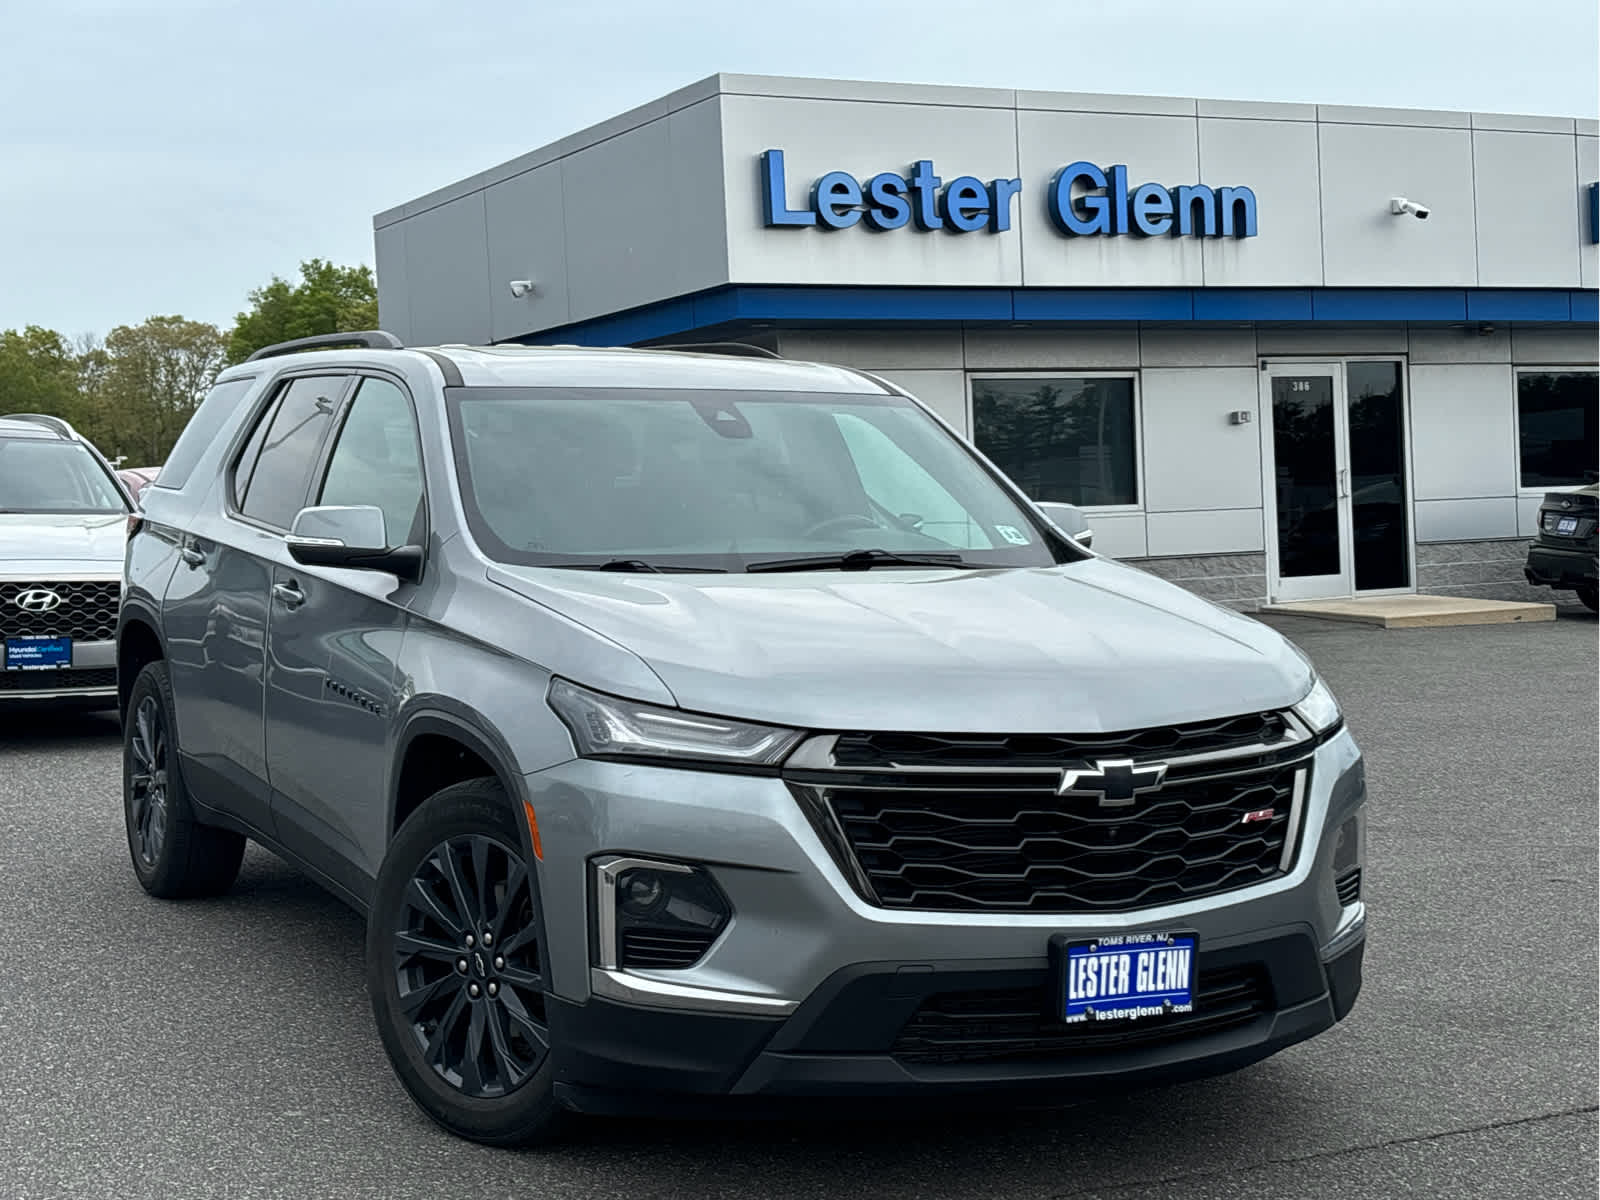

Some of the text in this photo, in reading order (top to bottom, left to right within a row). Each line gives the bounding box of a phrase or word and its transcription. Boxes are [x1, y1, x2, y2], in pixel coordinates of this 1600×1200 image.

[760, 149, 1259, 238] Lester Glenn
[1098, 936, 1124, 947] TOMS
[1156, 933, 1169, 942] NJ
[1068, 949, 1190, 1001] LESTER GLENN
[1095, 1006, 1163, 1021] lesterglenn
[1171, 1003, 1192, 1013] .com
